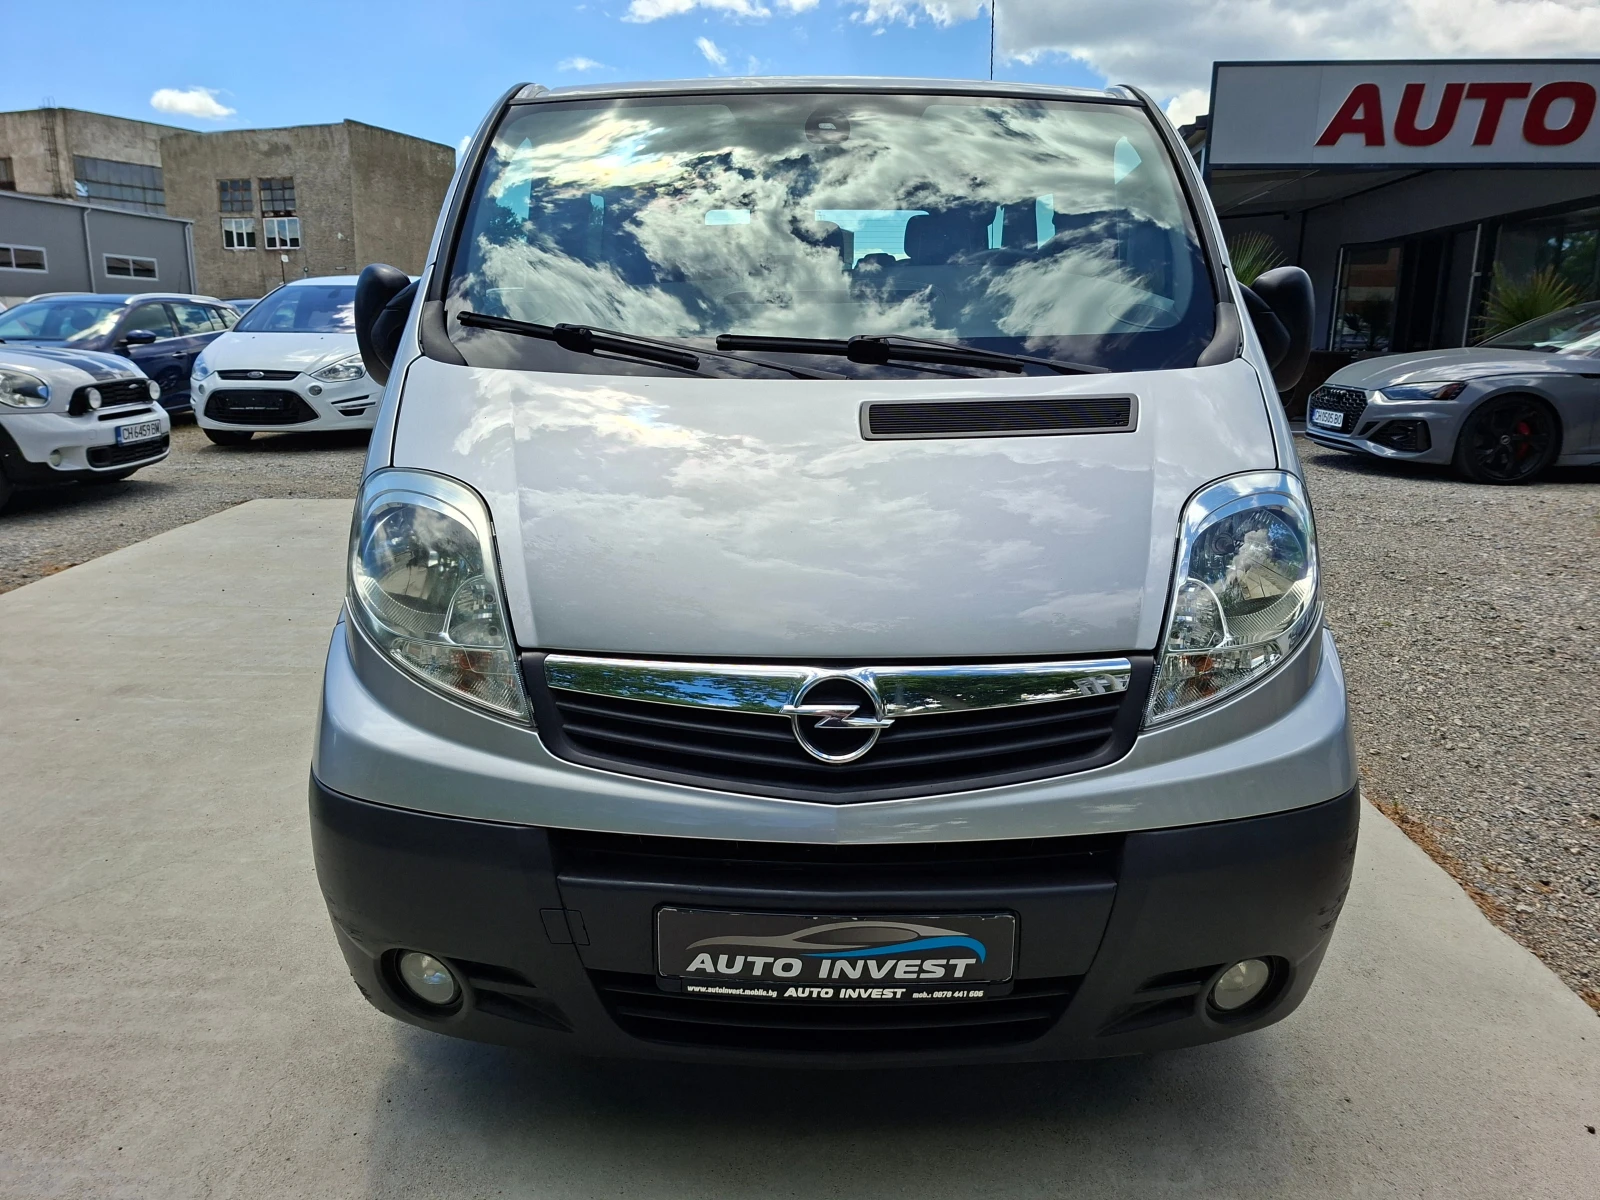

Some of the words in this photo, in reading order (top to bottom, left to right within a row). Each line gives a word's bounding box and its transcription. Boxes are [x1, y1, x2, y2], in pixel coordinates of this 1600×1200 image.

[1313, 81, 1597, 147] AUTO
[123, 427, 133, 440] CH
[134, 425, 150, 438] 6459
[686, 952, 803, 978] AUTO
[818, 957, 977, 979] INVEST
[783, 987, 834, 998] AUTO
[839, 988, 906, 999] INVEST
[953, 990, 968, 998] 441
